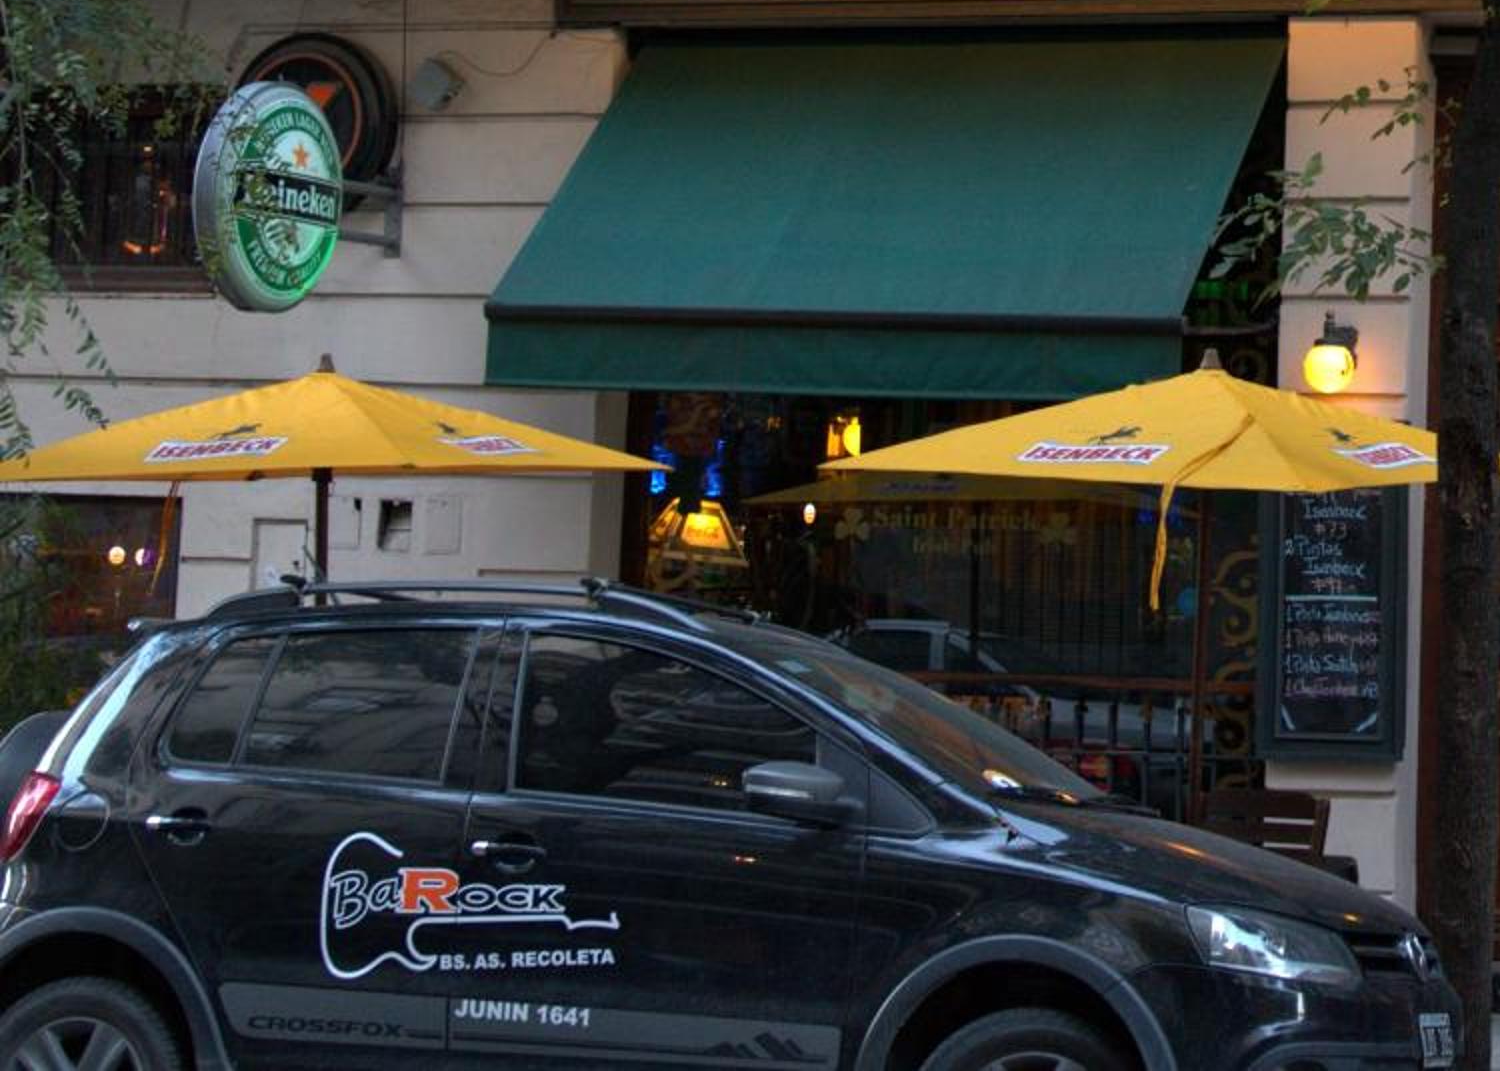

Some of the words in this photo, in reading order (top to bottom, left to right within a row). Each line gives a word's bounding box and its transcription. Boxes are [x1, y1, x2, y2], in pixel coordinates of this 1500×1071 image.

[152, 438, 280, 459] ISENBECK
[1024, 445, 1164, 462] ISENBECK
[439, 953, 471, 971] BS.
[474, 952, 506, 970] AS.
[511, 949, 616, 968] RECOLETA
[454, 998, 529, 1022] JUNIN
[536, 1005, 590, 1027] 1641
[248, 1015, 405, 1039] CROSSFOX
